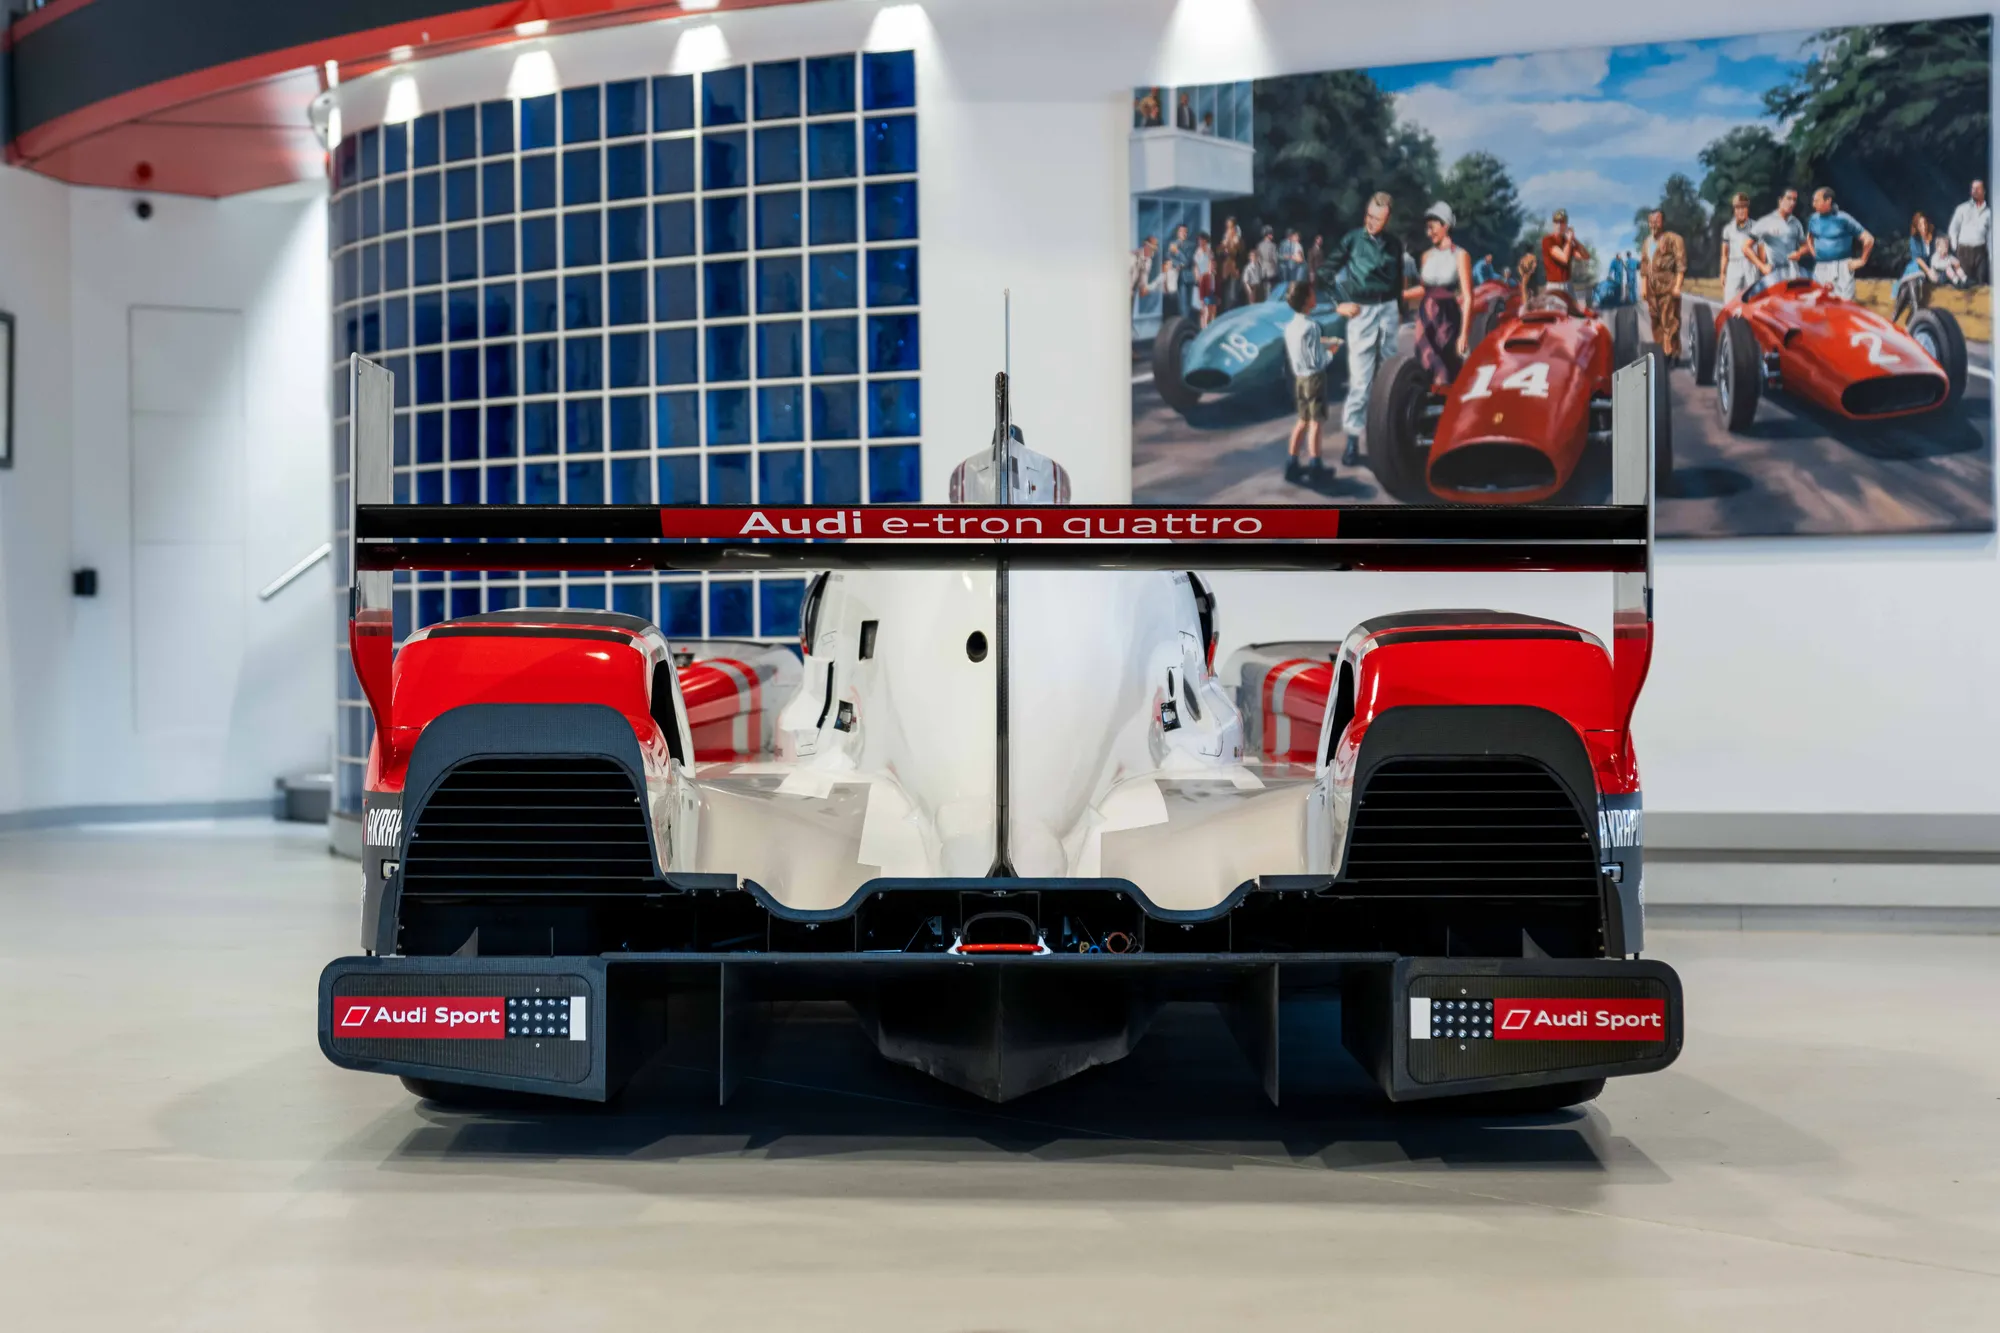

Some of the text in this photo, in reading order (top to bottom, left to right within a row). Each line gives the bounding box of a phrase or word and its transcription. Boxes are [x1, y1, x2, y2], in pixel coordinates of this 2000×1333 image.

[1219, 333, 1260, 363] 18
[1851, 331, 1901, 365] 2
[1460, 361, 1550, 403] 14
[738, 511, 1263, 538] Audi e-tron quattro
[366, 808, 402, 847] AKRAP
[373, 1006, 501, 1028] Audi Sport
[1533, 1010, 1662, 1030] Audi Sport
